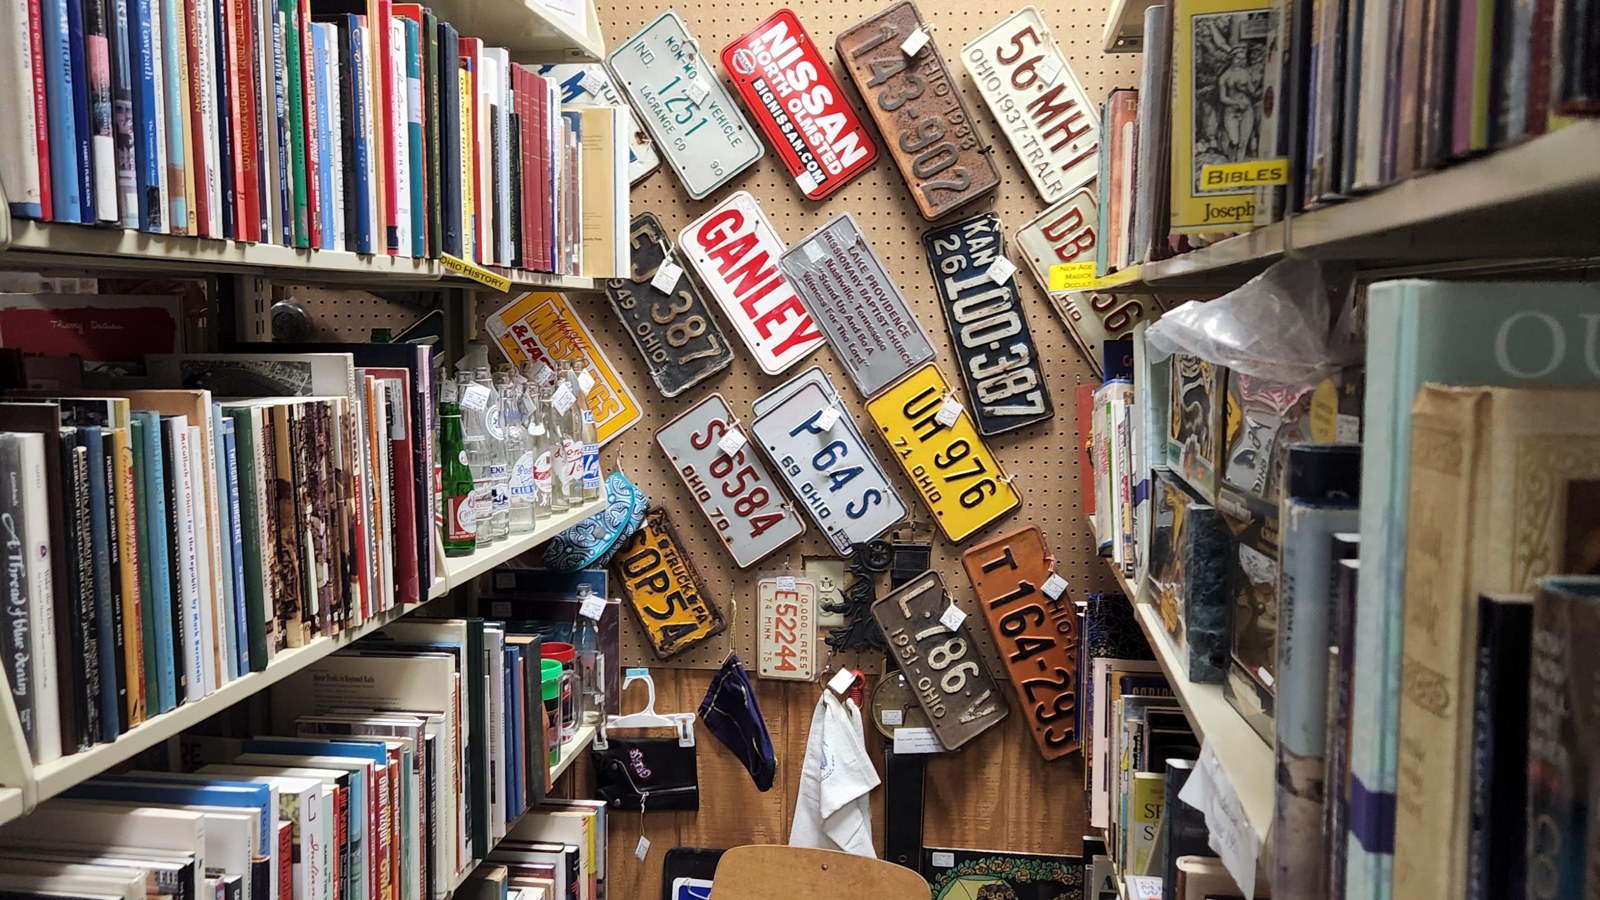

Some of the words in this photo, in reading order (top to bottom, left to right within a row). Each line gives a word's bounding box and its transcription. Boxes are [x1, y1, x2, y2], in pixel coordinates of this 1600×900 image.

[191, 8, 199, 48] YEARS
[274, 22, 283, 78] CONFRONTING
[736, 50, 753, 74] NISSAN
[193, 61, 201, 113] JORDAN
[239, 74, 249, 117] COUNTY
[276, 79, 284, 96] THE
[658, 76, 709, 136] 1251
[749, 39, 793, 99] NORTH
[787, 98, 843, 176] OLMSTED
[761, 20, 868, 169] NISSAN
[709, 101, 742, 148] VEHICLE
[752, 78, 827, 185] BIGNISSAN.COM
[852, 23, 971, 208] 143-902
[240, 122, 250, 172] CUYAHOGA
[398, 132, 406, 193] JOURNAL
[673, 137, 687, 152] CO
[710, 160, 723, 176] 90
[1207, 166, 1282, 185] BIBLES
[439, 254, 463, 272] OHIO
[463, 264, 505, 289] HISTORY
[933, 238, 967, 274] 26
[696, 208, 824, 358] GANLEY
[822, 230, 864, 288] MISSIONARY
[859, 286, 889, 329] BAPTIST
[885, 328, 915, 368] CHURCH
[847, 245, 869, 275] LAKE
[865, 274, 912, 340] PROVIDENCE
[1064, 281, 1092, 289] OCCULT
[608, 278, 637, 310] 949
[636, 321, 669, 363] OHIO
[651, 290, 723, 365] 387
[802, 271, 828, 308] Witness
[825, 306, 838, 324] For
[837, 322, 850, 343] The
[836, 299, 848, 315] Up
[844, 313, 861, 334] And
[857, 332, 867, 347] Be
[866, 346, 875, 356] A
[854, 302, 887, 352] Tennessee
[1059, 293, 1083, 323] HIO
[512, 323, 529, 340] &
[351, 412, 359, 472] FOOTBALL
[73, 447, 82, 508] CELEBRATION
[106, 455, 115, 494] PIONEERS
[184, 480, 191, 490] of
[228, 447, 239, 486] TWILIGHT
[781, 455, 802, 478] 69
[800, 482, 832, 520] OHIO
[912, 465, 942, 505] OHIO
[934, 439, 997, 510] 976
[108, 494, 116, 507] OF
[128, 473, 136, 519] CLEVELAND
[231, 486, 239, 498] OF
[682, 464, 712, 504] OHIO
[710, 506, 731, 532] 70
[130, 520, 138, 564] CHRISTMAS
[232, 499, 242, 545] INNOCENCE
[76, 519, 85, 571] CLEVELAND
[83, 515, 94, 576] CELEBRATION
[7, 550, 26, 605] Thread
[186, 554, 196, 594] Republic
[663, 549, 697, 597] TRUCK
[691, 604, 709, 626] PA
[80, 583, 88, 615] COLOR
[190, 598, 198, 610] by
[763, 597, 773, 610] 74
[12, 618, 29, 651] blue
[192, 613, 200, 638] Mark
[83, 652, 92, 680] JONES
[194, 639, 202, 684] Bernstein
[763, 650, 772, 663] 75
[800, 633, 808, 670] LAKES
[13, 651, 31, 697] denim
[917, 677, 946, 719] OHIO
[338, 785, 350, 808] Epic
[378, 774, 389, 808] OMAR
[339, 809, 349, 848] Season
[377, 809, 390, 850] VIZQUEL
[324, 867, 329, 877] OF
